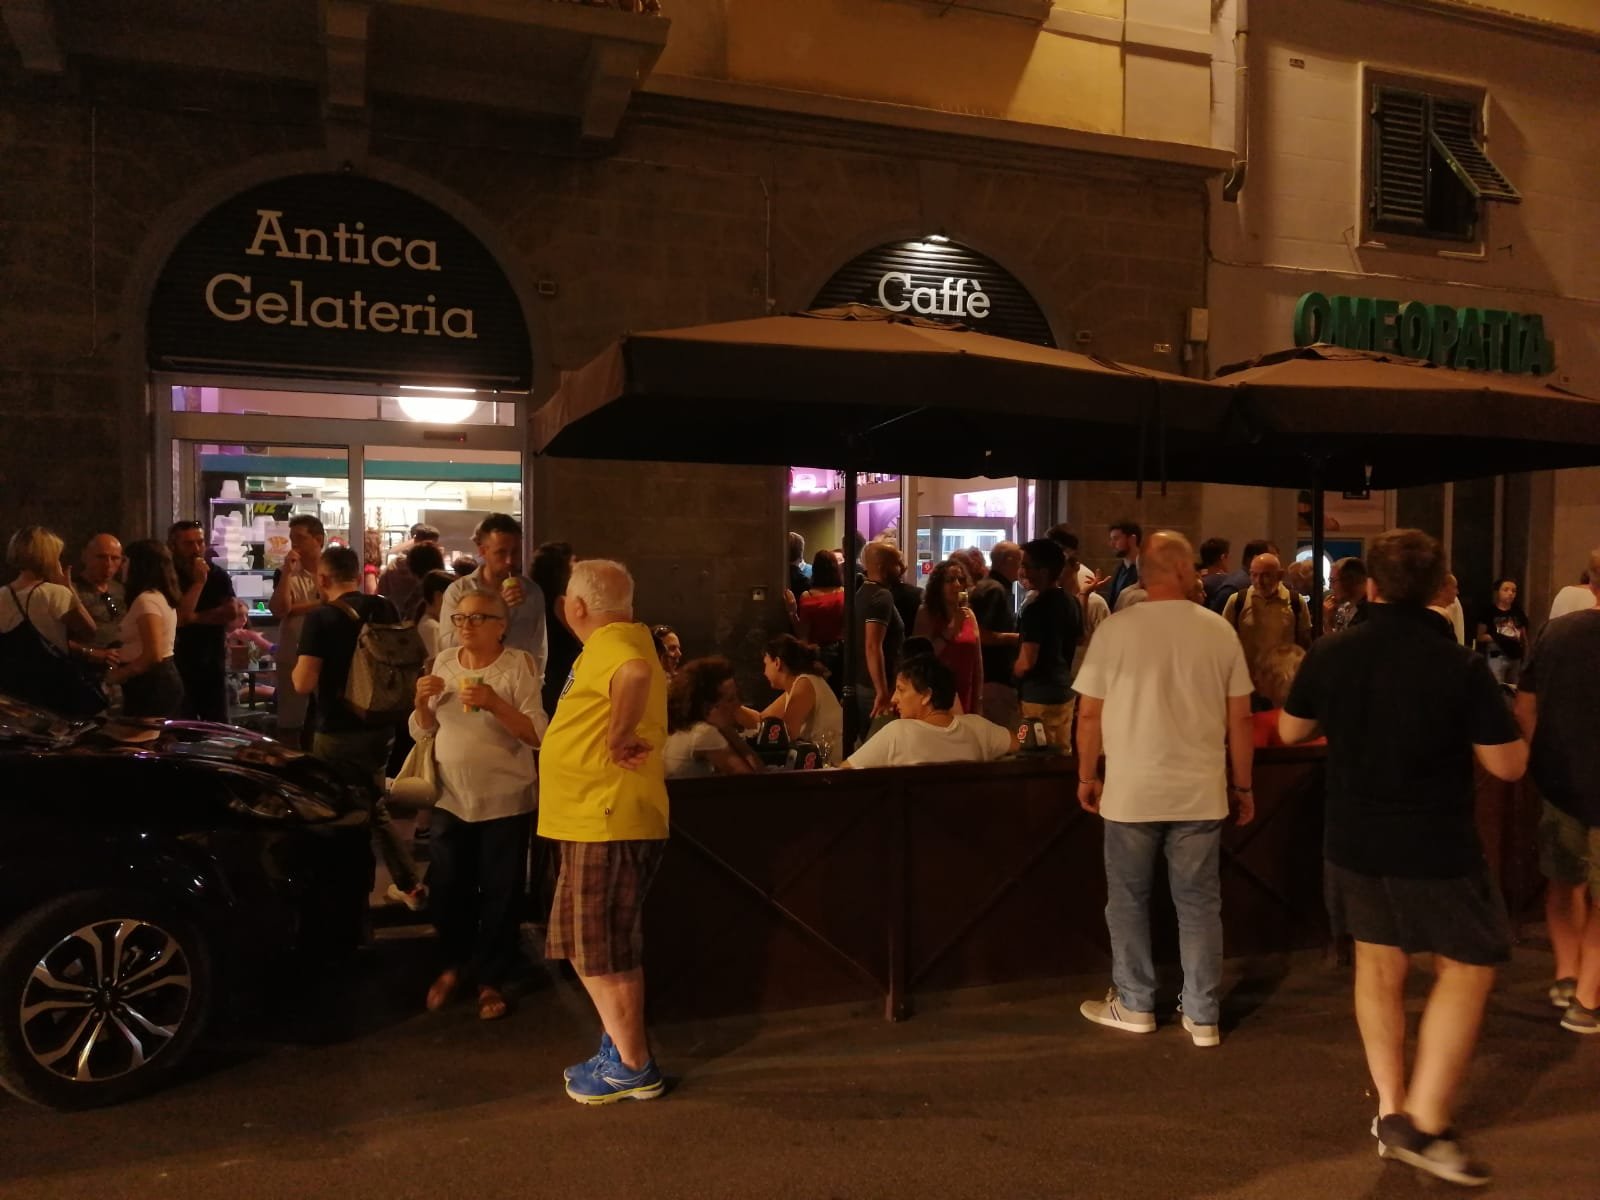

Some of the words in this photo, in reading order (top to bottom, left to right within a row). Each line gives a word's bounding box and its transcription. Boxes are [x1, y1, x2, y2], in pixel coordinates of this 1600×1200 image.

[245, 208, 442, 271] Antica
[205, 272, 478, 339] Gelateria
[878, 271, 991, 319] Caffè
[1294, 291, 1554, 376] OMEOPATIA
